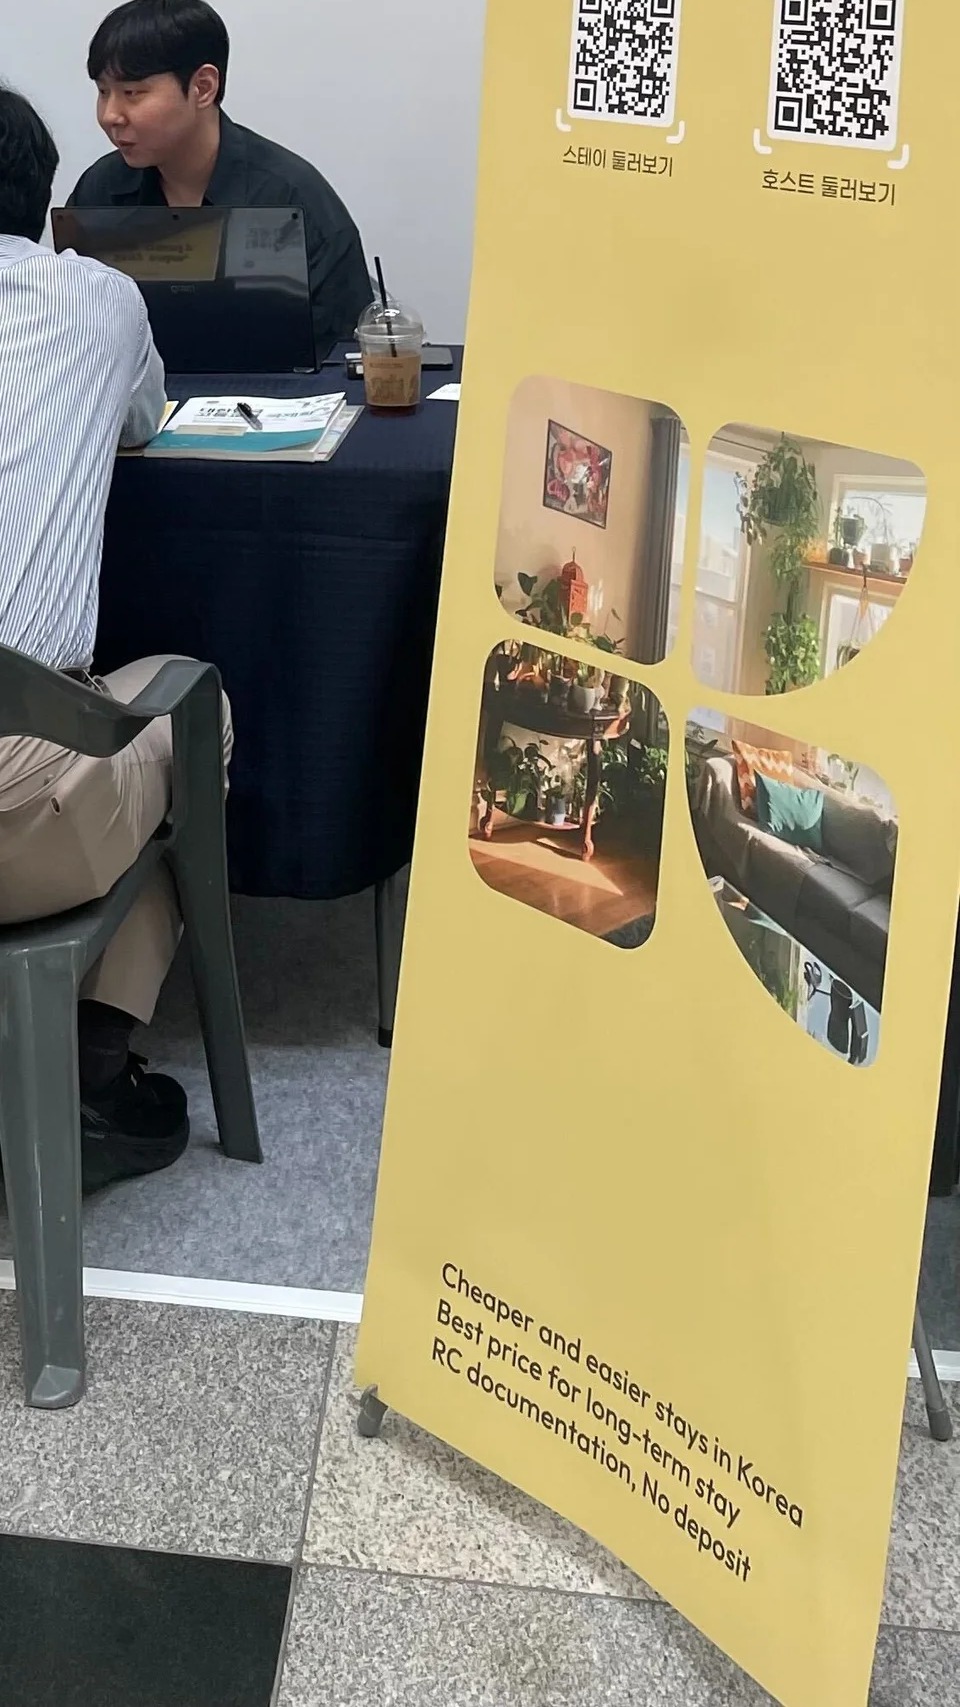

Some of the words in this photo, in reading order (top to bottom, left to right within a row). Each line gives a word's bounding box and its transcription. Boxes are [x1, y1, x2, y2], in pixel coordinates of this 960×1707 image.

[562, 145, 607, 169] 스테이
[612, 150, 673, 178] 둘러보기
[761, 168, 815, 195] 호스트
[821, 175, 896, 206] 둘러보기
[432, 1336, 463, 1374] RC
[466, 1361, 636, 1493] documentation,
[642, 1471, 670, 1515] No
[674, 1503, 751, 1583] deposit
[437, 1298, 484, 1346] Best
[486, 1334, 543, 1381] price
[547, 1365, 582, 1403] for
[586, 1387, 691, 1488] long-term
[694, 1477, 741, 1529] stay
[442, 1262, 535, 1333] Cheaper
[539, 1325, 582, 1364] and
[585, 1354, 651, 1408] easier
[654, 1401, 709, 1455] stays
[713, 1436, 731, 1474] in
[737, 1455, 803, 1529] Korea
